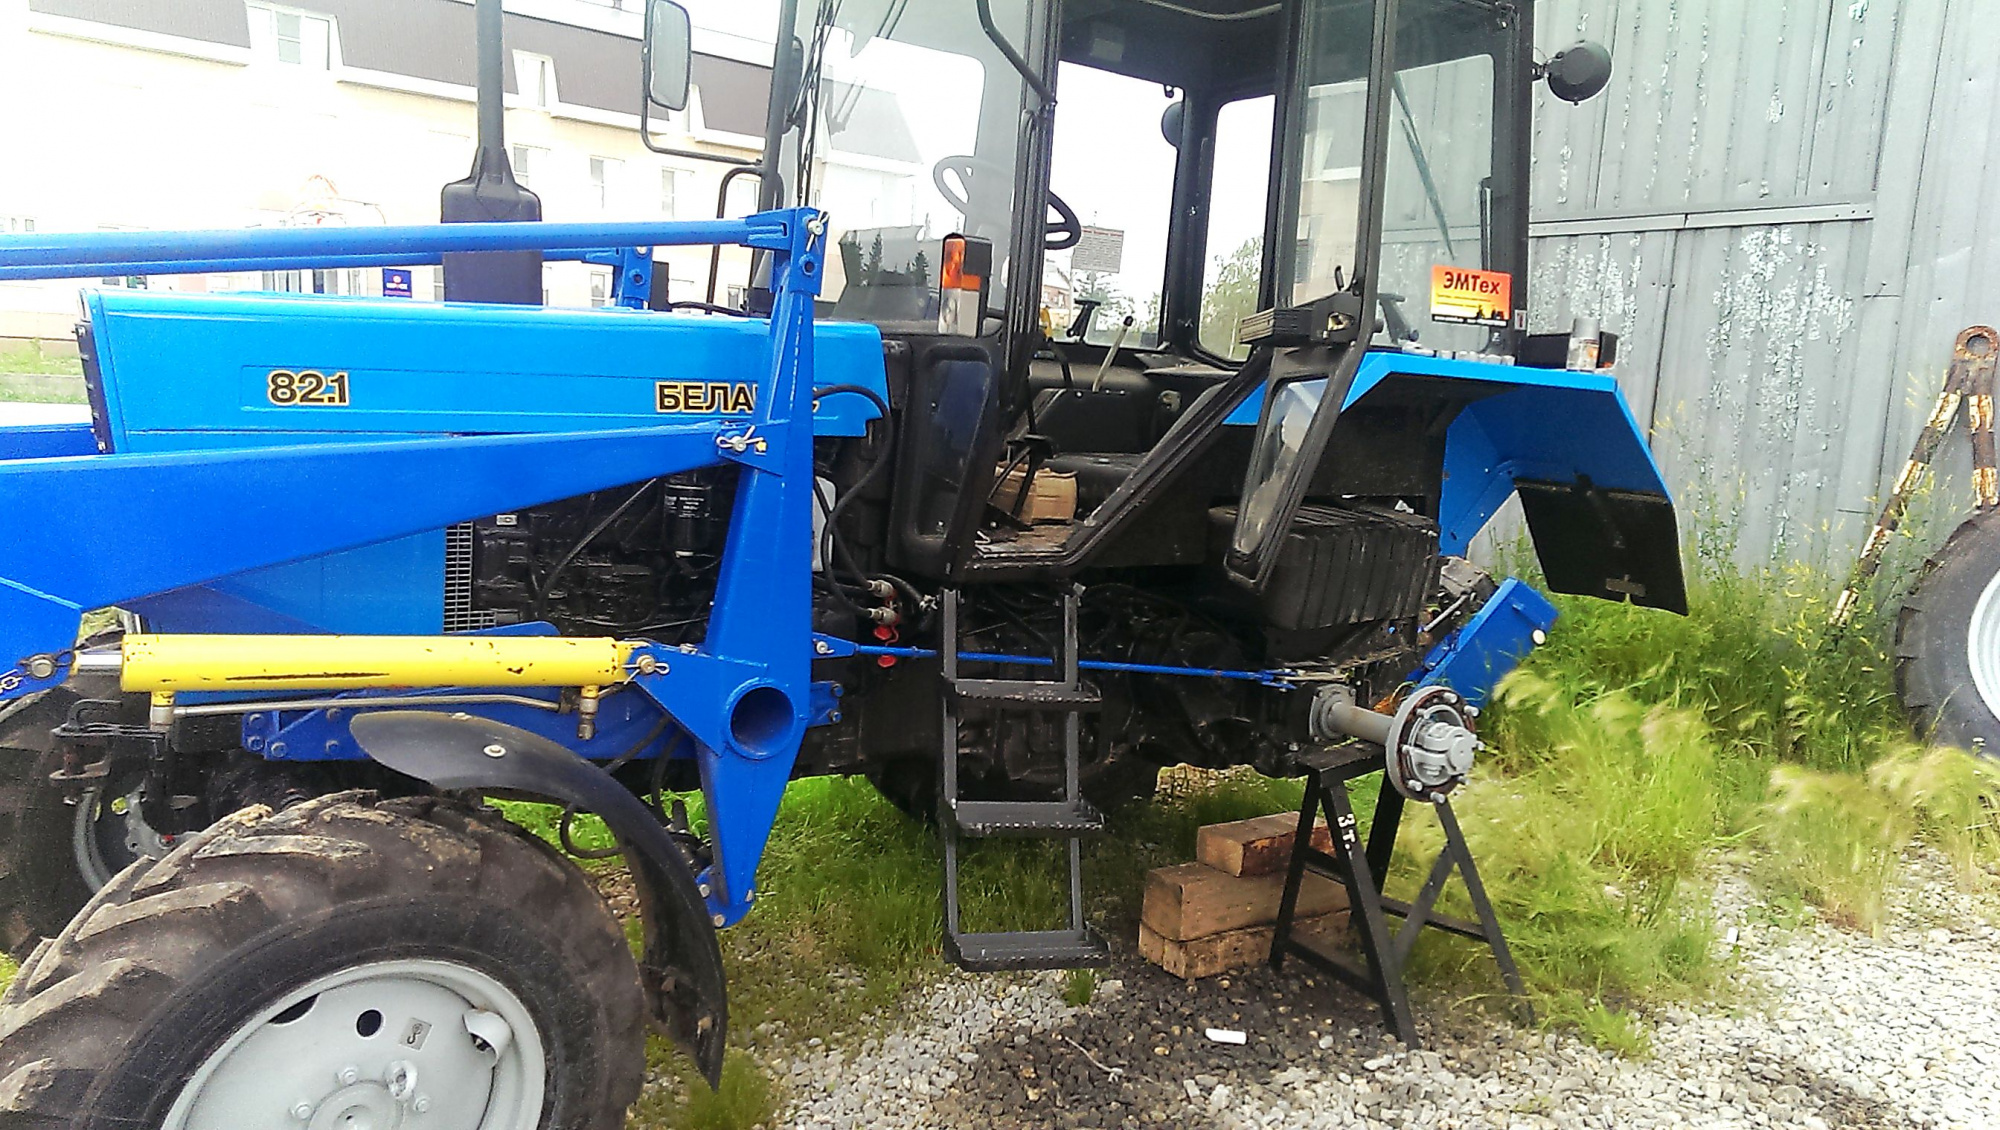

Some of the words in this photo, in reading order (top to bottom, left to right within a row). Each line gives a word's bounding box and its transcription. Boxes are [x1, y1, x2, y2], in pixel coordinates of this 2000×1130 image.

[1443, 271, 1500, 295] ЭМТех
[268, 369, 349, 406] 82.1
[656, 381, 821, 416] БЕЛА
